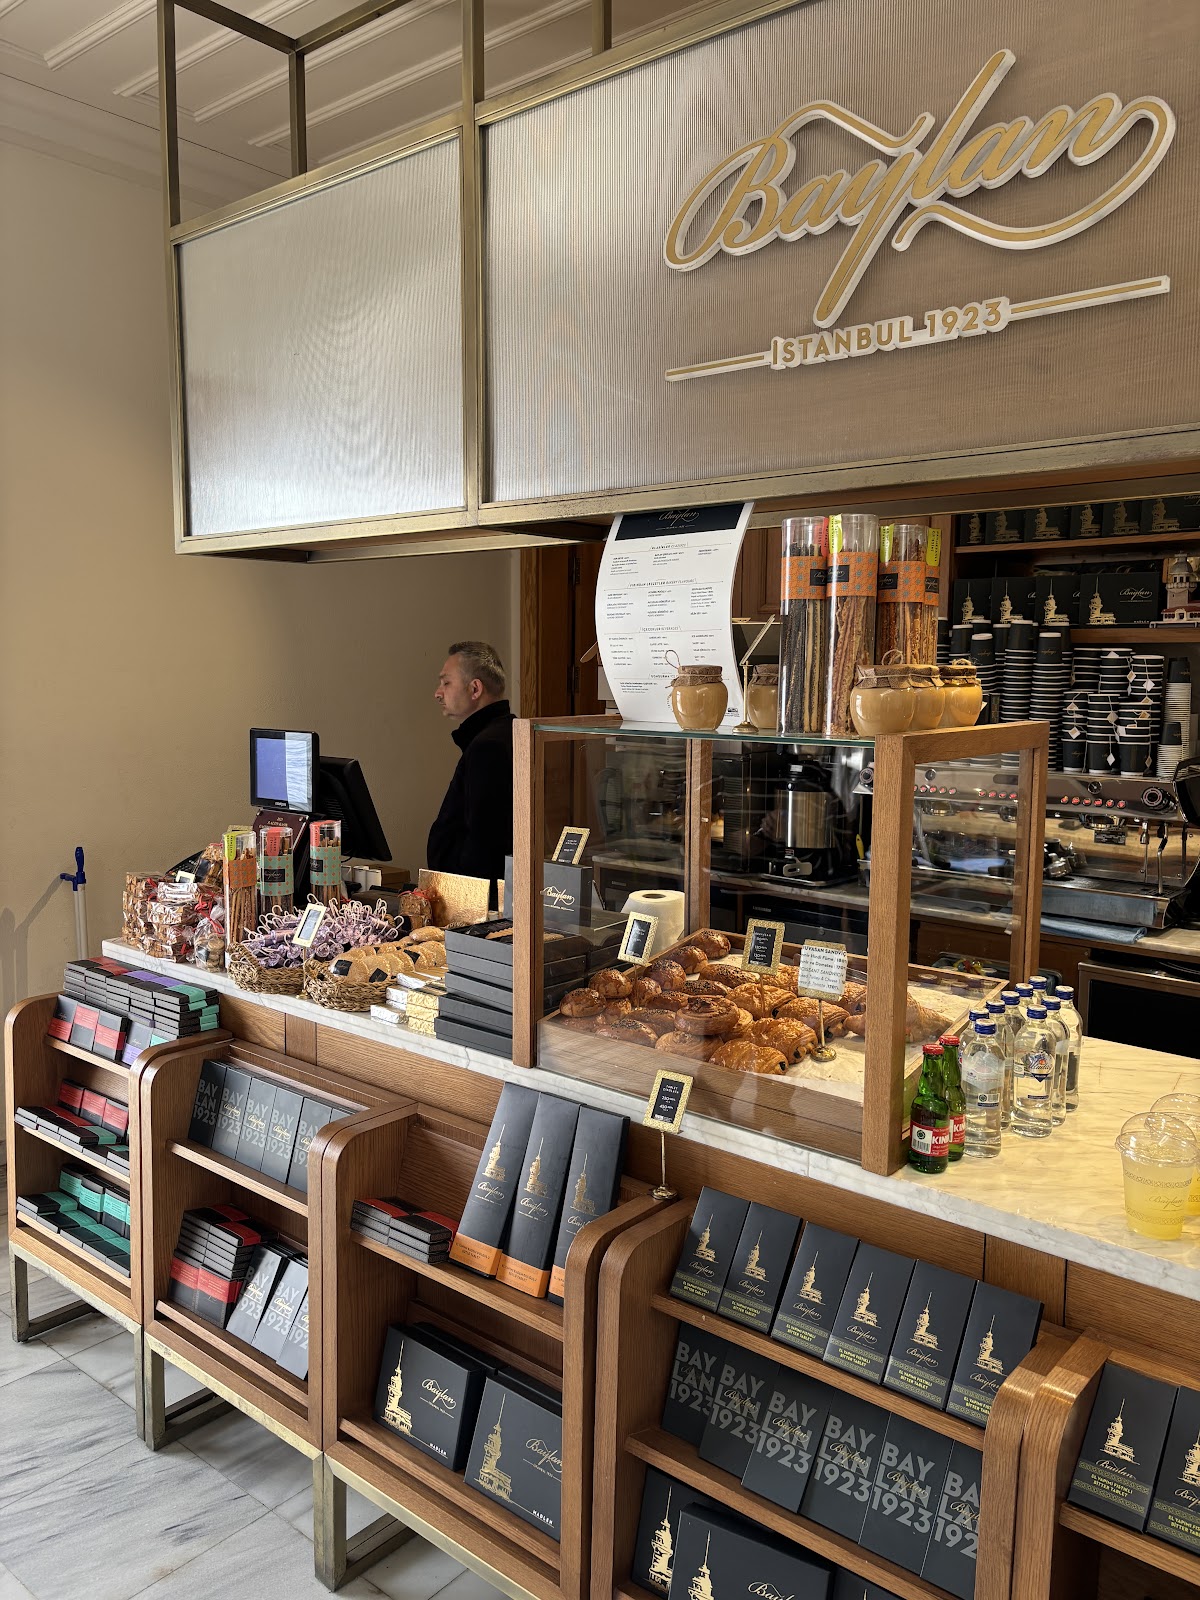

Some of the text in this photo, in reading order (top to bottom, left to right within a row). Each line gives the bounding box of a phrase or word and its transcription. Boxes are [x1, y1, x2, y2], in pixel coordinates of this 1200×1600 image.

[664, 49, 1176, 327] Baylan
[926, 300, 1004, 340] 1923
[1120, 587, 1152, 600] Baylan
[540, 886, 575, 905] Baylan
[195, 1091, 217, 1111] LAN
[198, 1080, 218, 1098] BAY
[221, 1088, 243, 1107] BAY
[194, 1105, 217, 1126] 1923
[245, 1098, 268, 1118] BAY
[271, 1108, 294, 1130] BAY
[217, 1113, 242, 1135] 1923
[241, 1125, 267, 1148] 1923
[266, 1136, 293, 1160] 1923
[293, 1147, 309, 1166] 19
[477, 1181, 505, 1200] Baylan
[520, 1197, 548, 1217] Baylan
[275, 1281, 300, 1303] BAY
[738, 1280, 766, 1297] Baylan
[262, 1310, 292, 1336] 1923
[793, 1302, 822, 1321] Baylan
[288, 1326, 308, 1350] 192
[846, 1325, 878, 1344] Baylan
[676, 1340, 717, 1374] BAY
[906, 1347, 939, 1368] Baylan
[673, 1359, 715, 1395] LAN
[719, 1364, 765, 1398] BAY
[421, 1379, 457, 1410] Baylan
[723, 1389, 759, 1413] Baylan
[768, 1391, 817, 1427] BAY
[710, 1404, 761, 1444] 1923
[772, 1417, 809, 1443] Baylan
[825, 1415, 876, 1453] BAY
[429, 1442, 447, 1456] MADLEN
[756, 1431, 812, 1474] 1923
[829, 1442, 869, 1469] Baylan
[881, 1441, 935, 1482] BAY
[814, 1457, 872, 1502] 1923
[886, 1471, 929, 1500] Baylan
[943, 1470, 979, 1508] BA
[871, 1486, 933, 1534] 1923
[1174, 1488, 1200, 1508] Bay
[532, 1509, 553, 1526] MADLEN
[934, 1517, 978, 1560] 192
